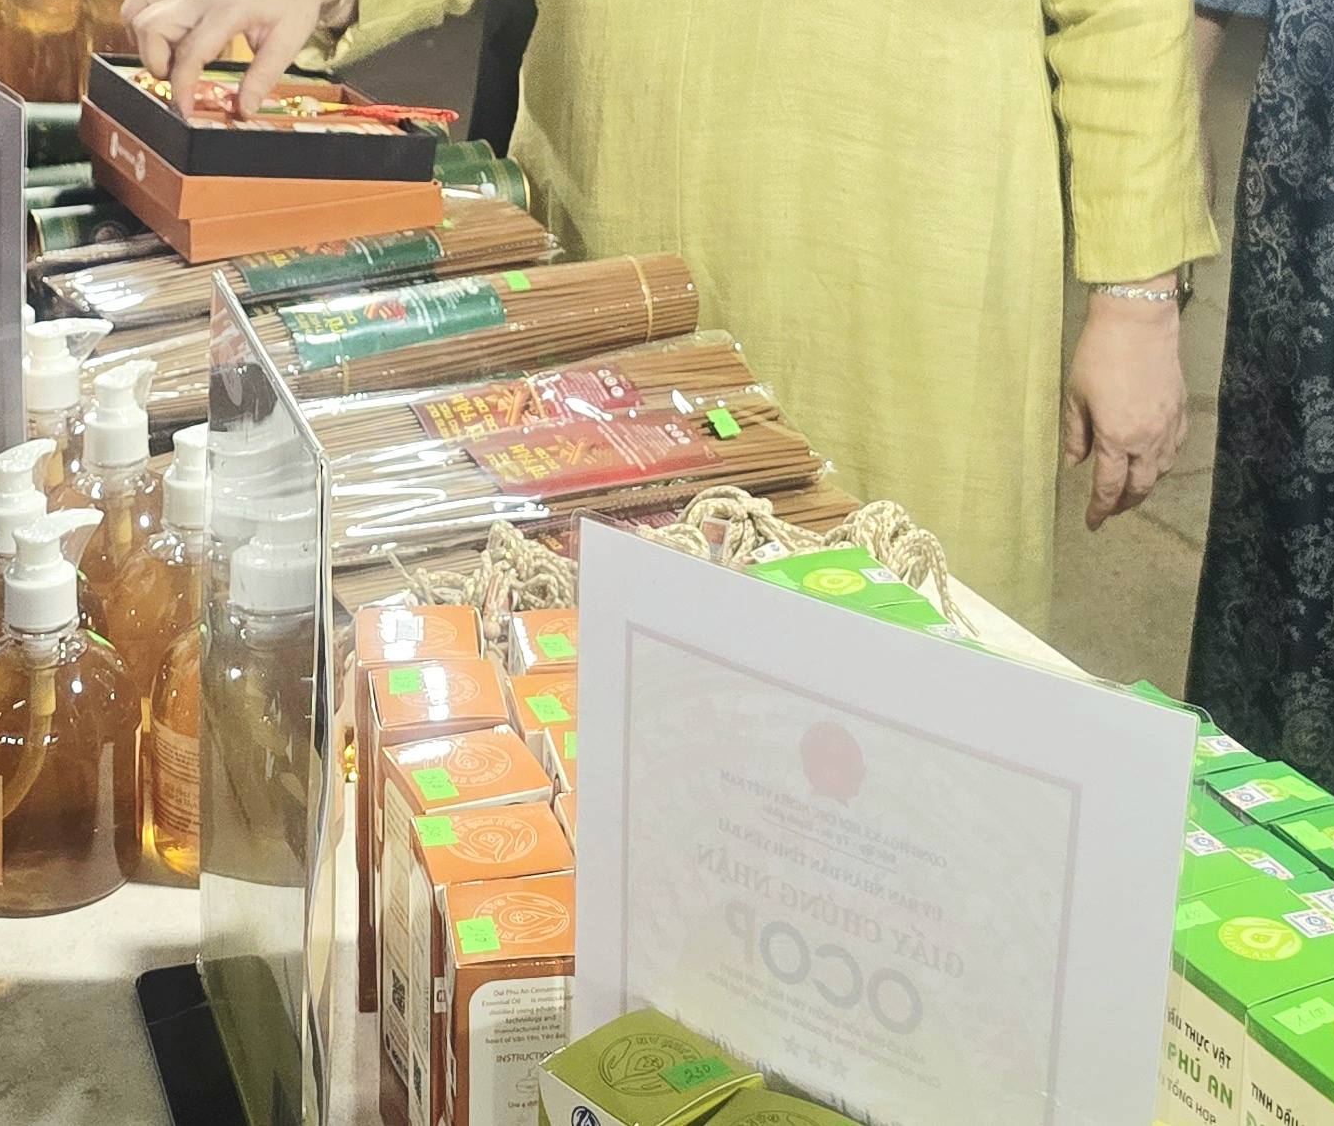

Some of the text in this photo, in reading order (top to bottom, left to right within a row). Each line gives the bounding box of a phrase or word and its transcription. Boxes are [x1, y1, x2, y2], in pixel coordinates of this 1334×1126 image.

[1184, 1021, 1210, 1054] THỰC
[1212, 1042, 1233, 1071] VẬT
[1166, 1040, 1234, 1110] PHÚ AN
[1251, 1081, 1274, 1112] TINH
[1167, 1075, 1217, 1126] TỔNG HỢP
